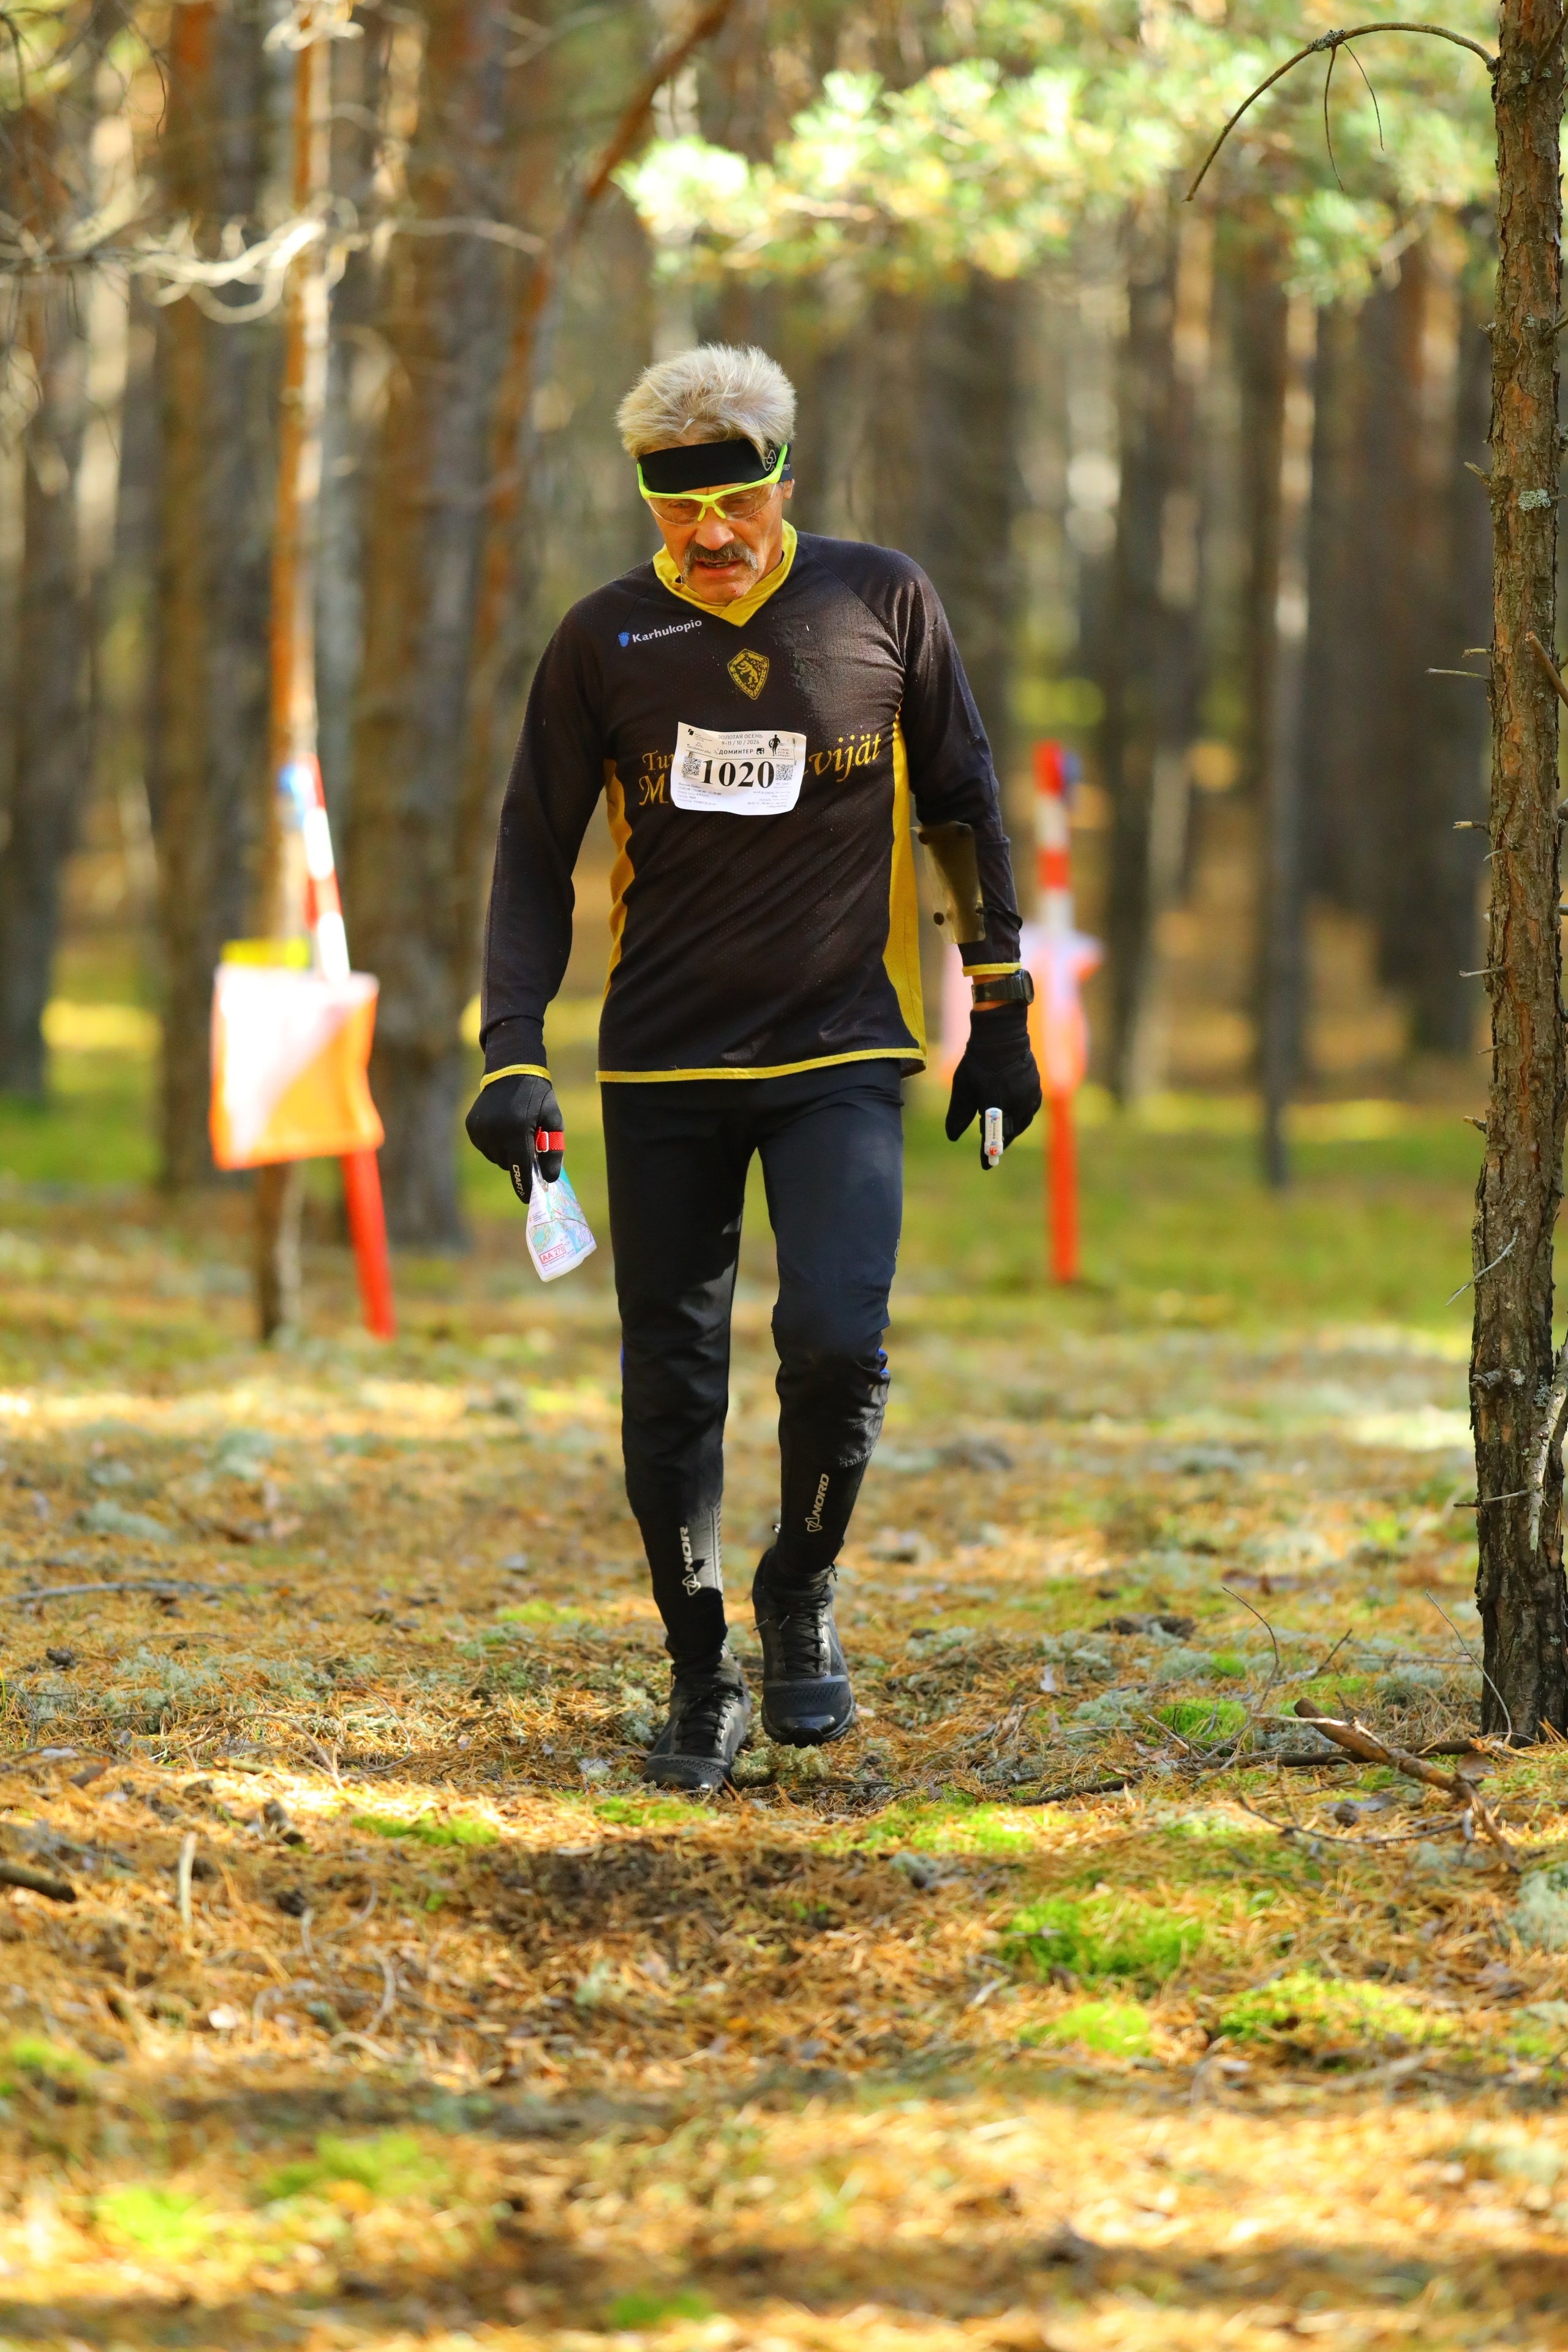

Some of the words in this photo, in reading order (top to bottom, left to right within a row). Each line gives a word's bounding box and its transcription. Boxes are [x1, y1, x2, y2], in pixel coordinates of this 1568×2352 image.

[632, 620, 702, 643] Karhukopio
[809, 733, 881, 782] vijät
[702, 760, 774, 788] 1020
[512, 1164, 524, 1191] CRAFT
[542, 1252, 554, 1262] AA
[553, 1246, 565, 1256] 270
[812, 1473, 829, 1518] NORD
[679, 1526, 694, 1572] NOR
